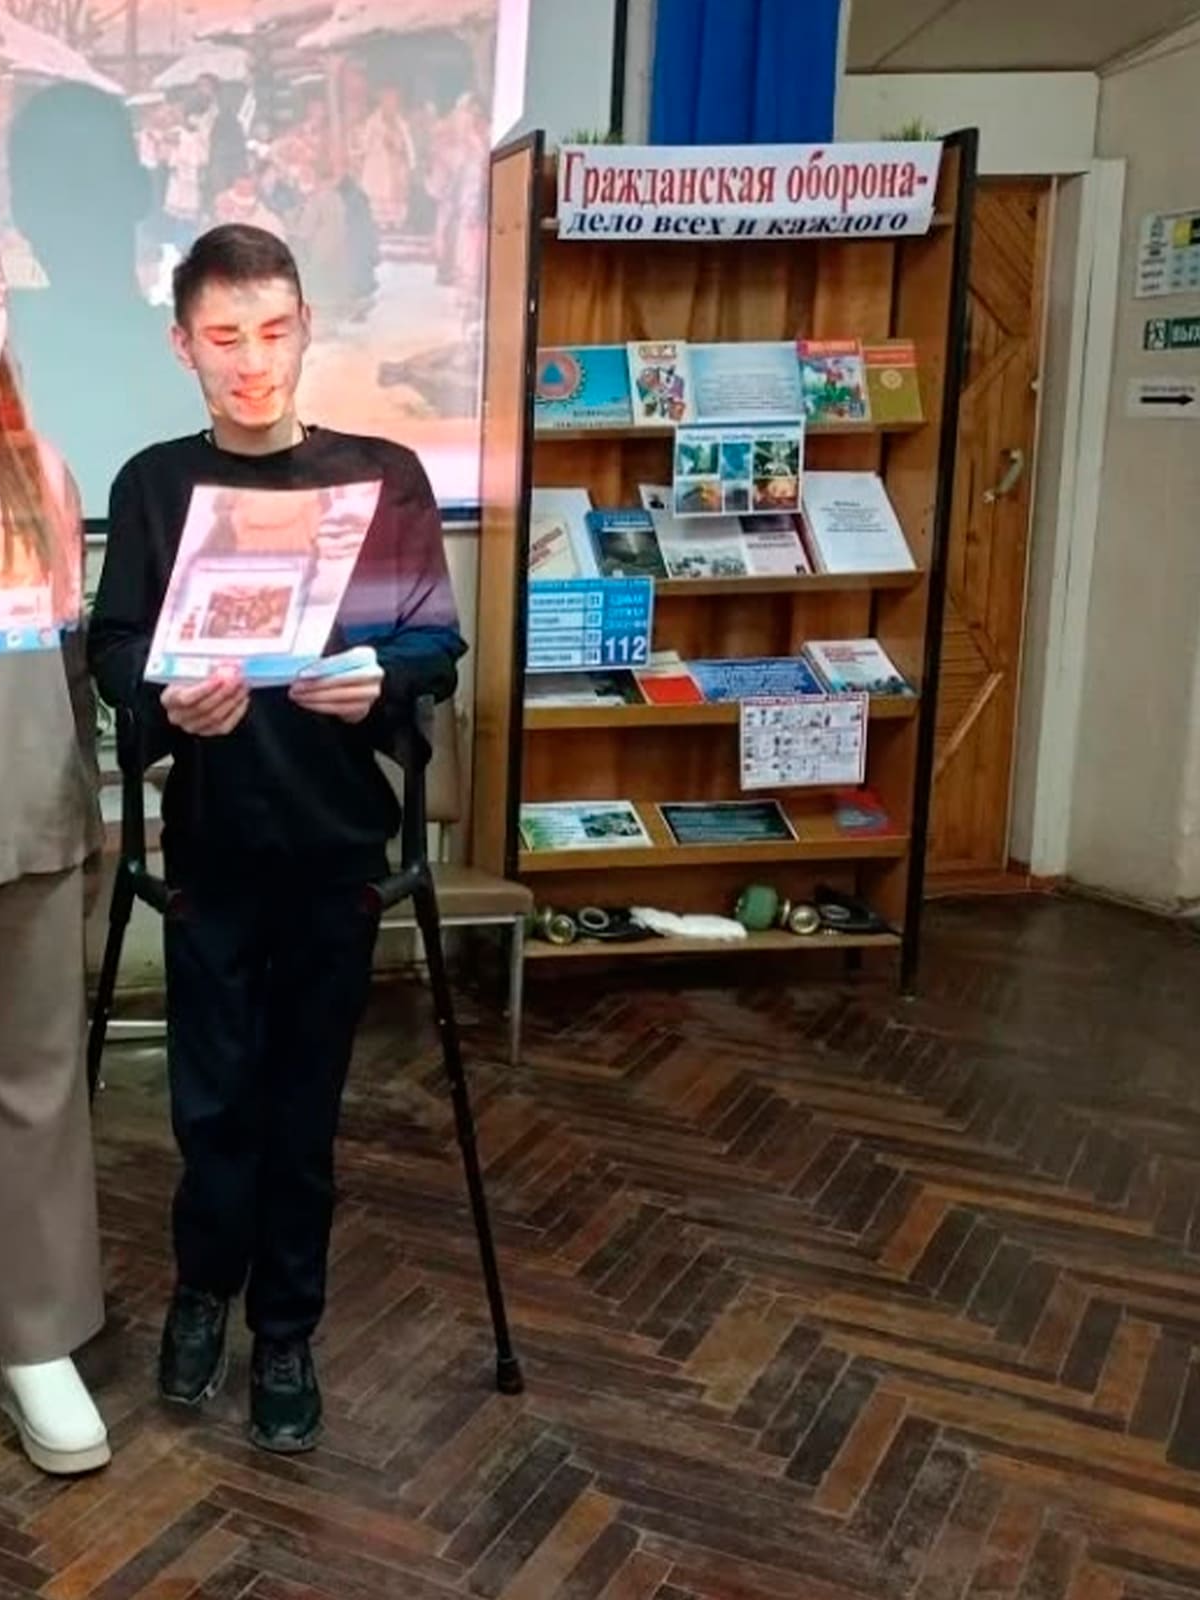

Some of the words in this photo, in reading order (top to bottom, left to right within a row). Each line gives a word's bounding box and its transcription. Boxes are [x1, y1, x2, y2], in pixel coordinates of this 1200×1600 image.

[564, 152, 776, 209] Гражданская
[787, 150, 928, 213] оборона-
[566, 211, 643, 234] дело
[653, 214, 724, 236] всех
[733, 218, 757, 236] и
[766, 212, 908, 236] каждого
[605, 636, 647, 661] 112
